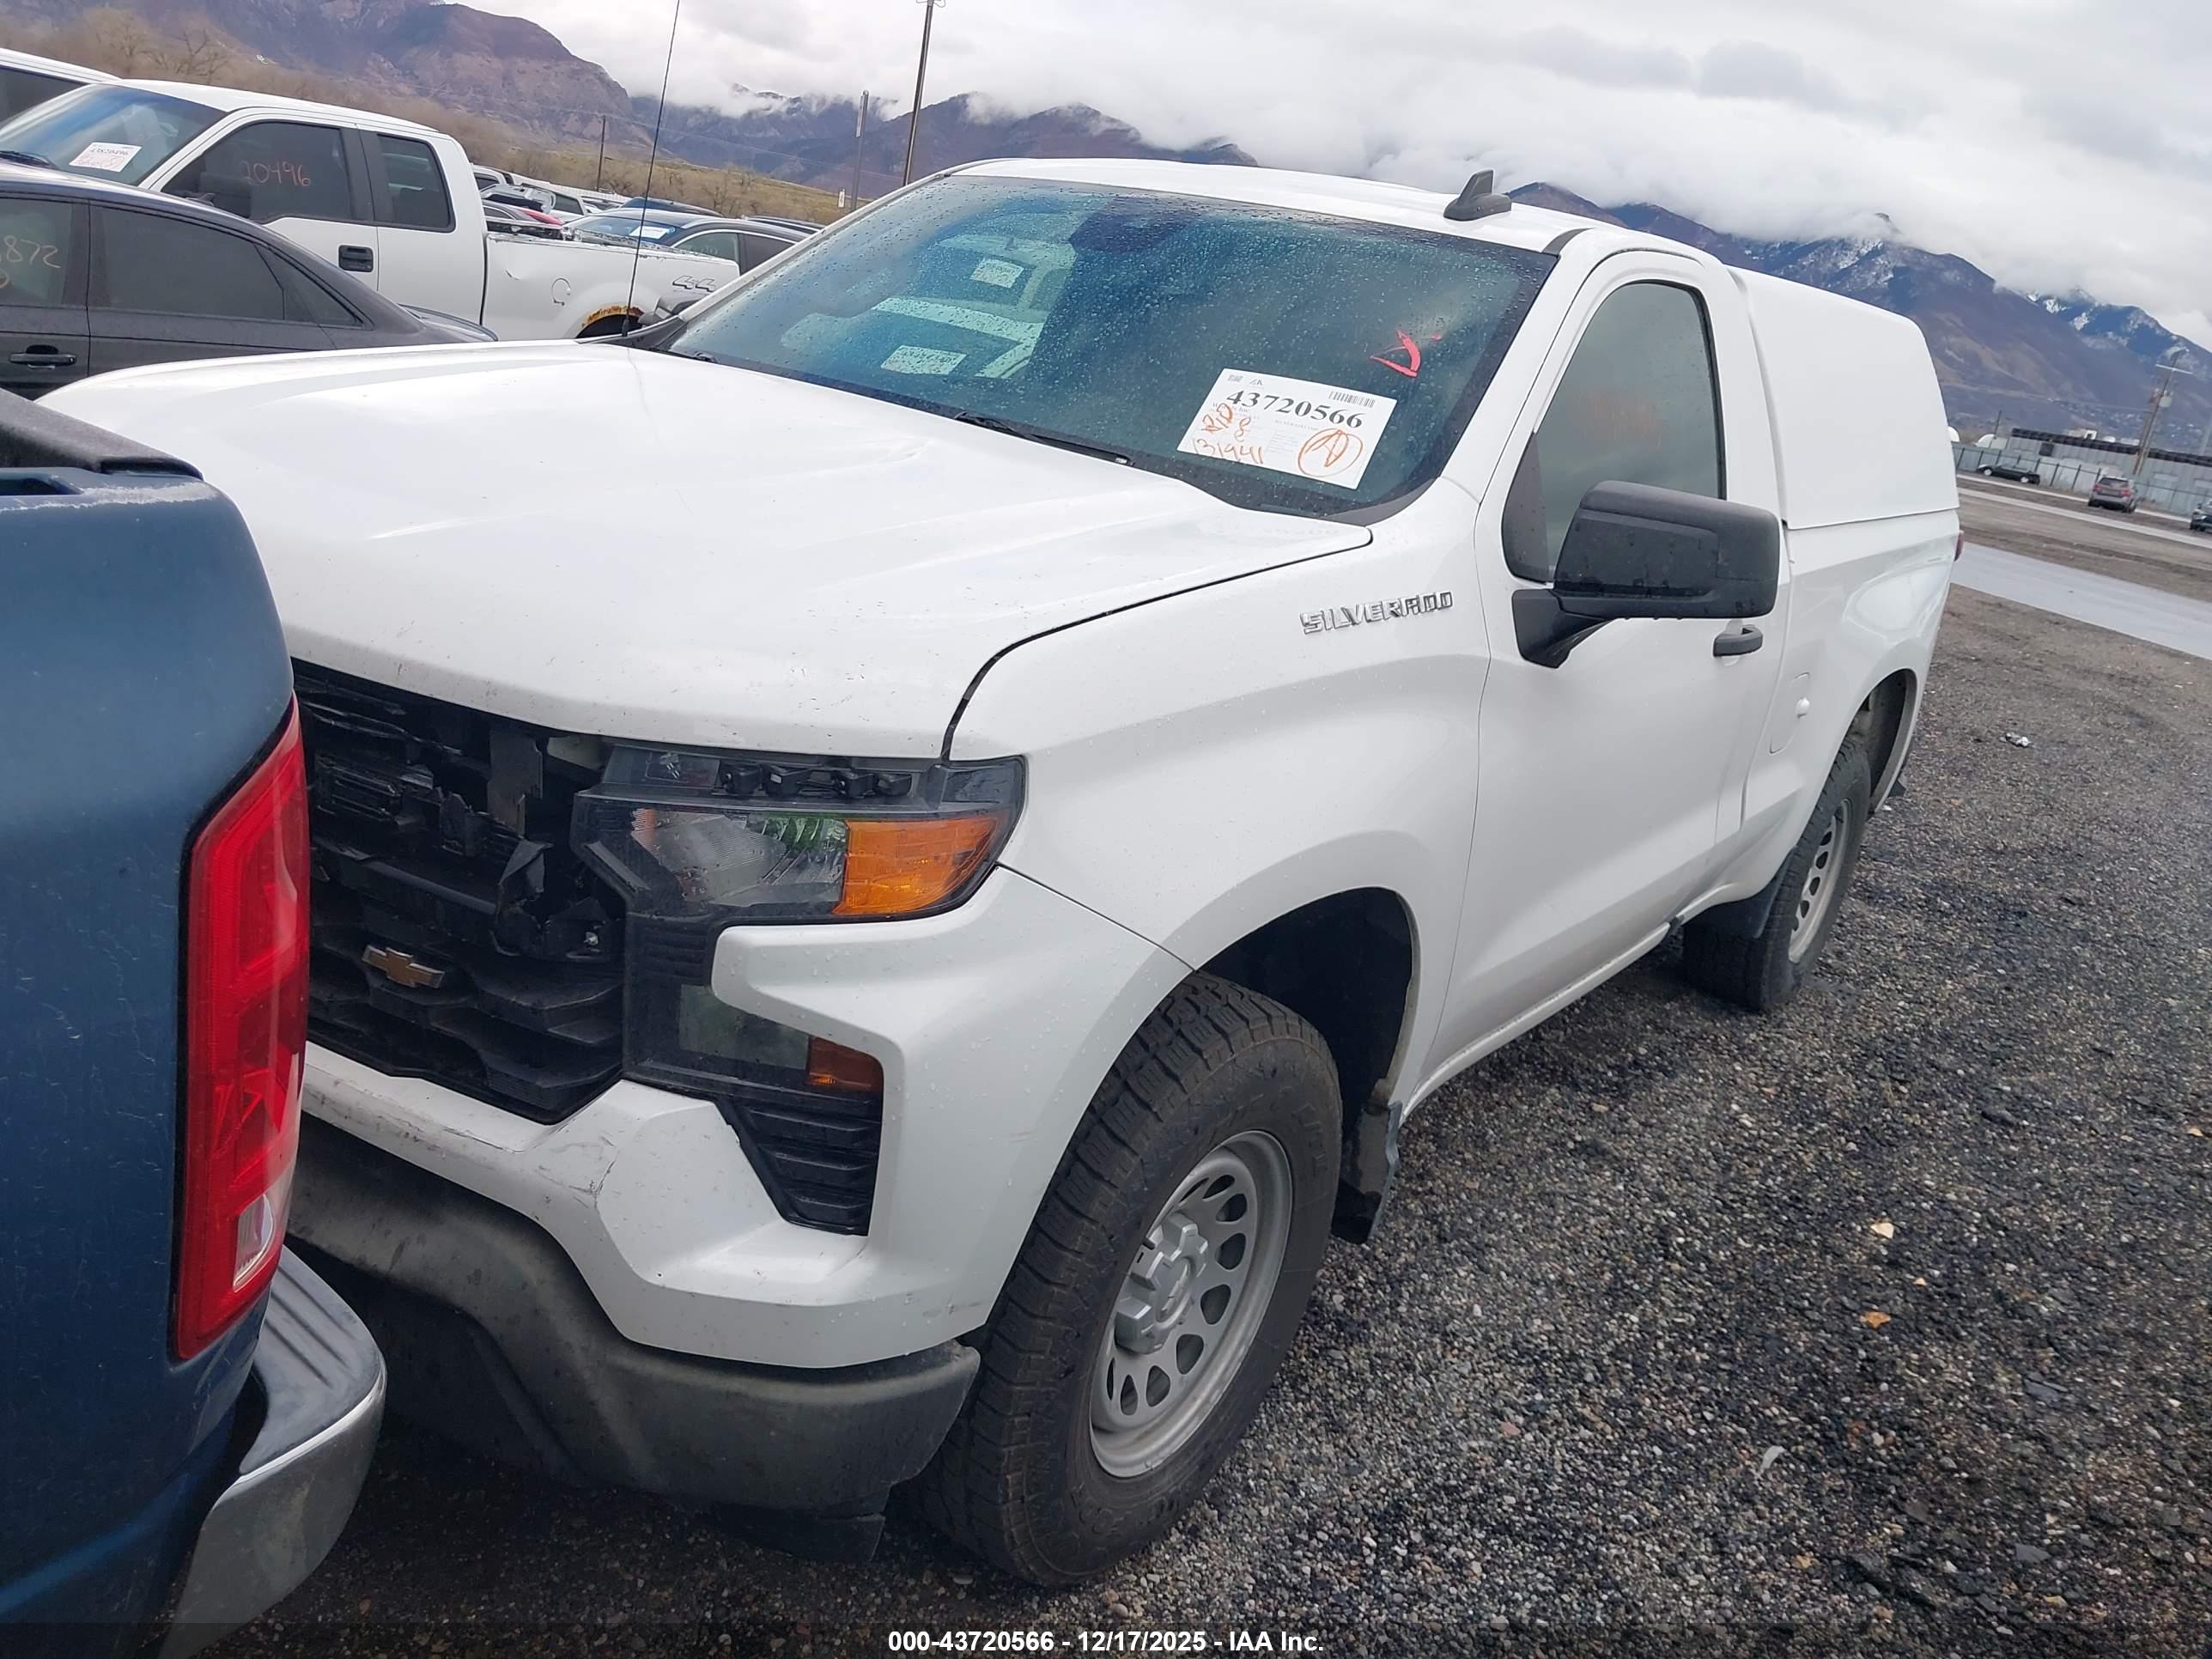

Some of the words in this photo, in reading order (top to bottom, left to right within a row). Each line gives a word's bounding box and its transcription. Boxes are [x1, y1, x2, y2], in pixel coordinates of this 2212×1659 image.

[240, 160, 311, 186] 20496
[0, 234, 62, 268] 872
[1226, 389, 1365, 429] 43720566
[1300, 591, 1454, 635] SILVERADO
